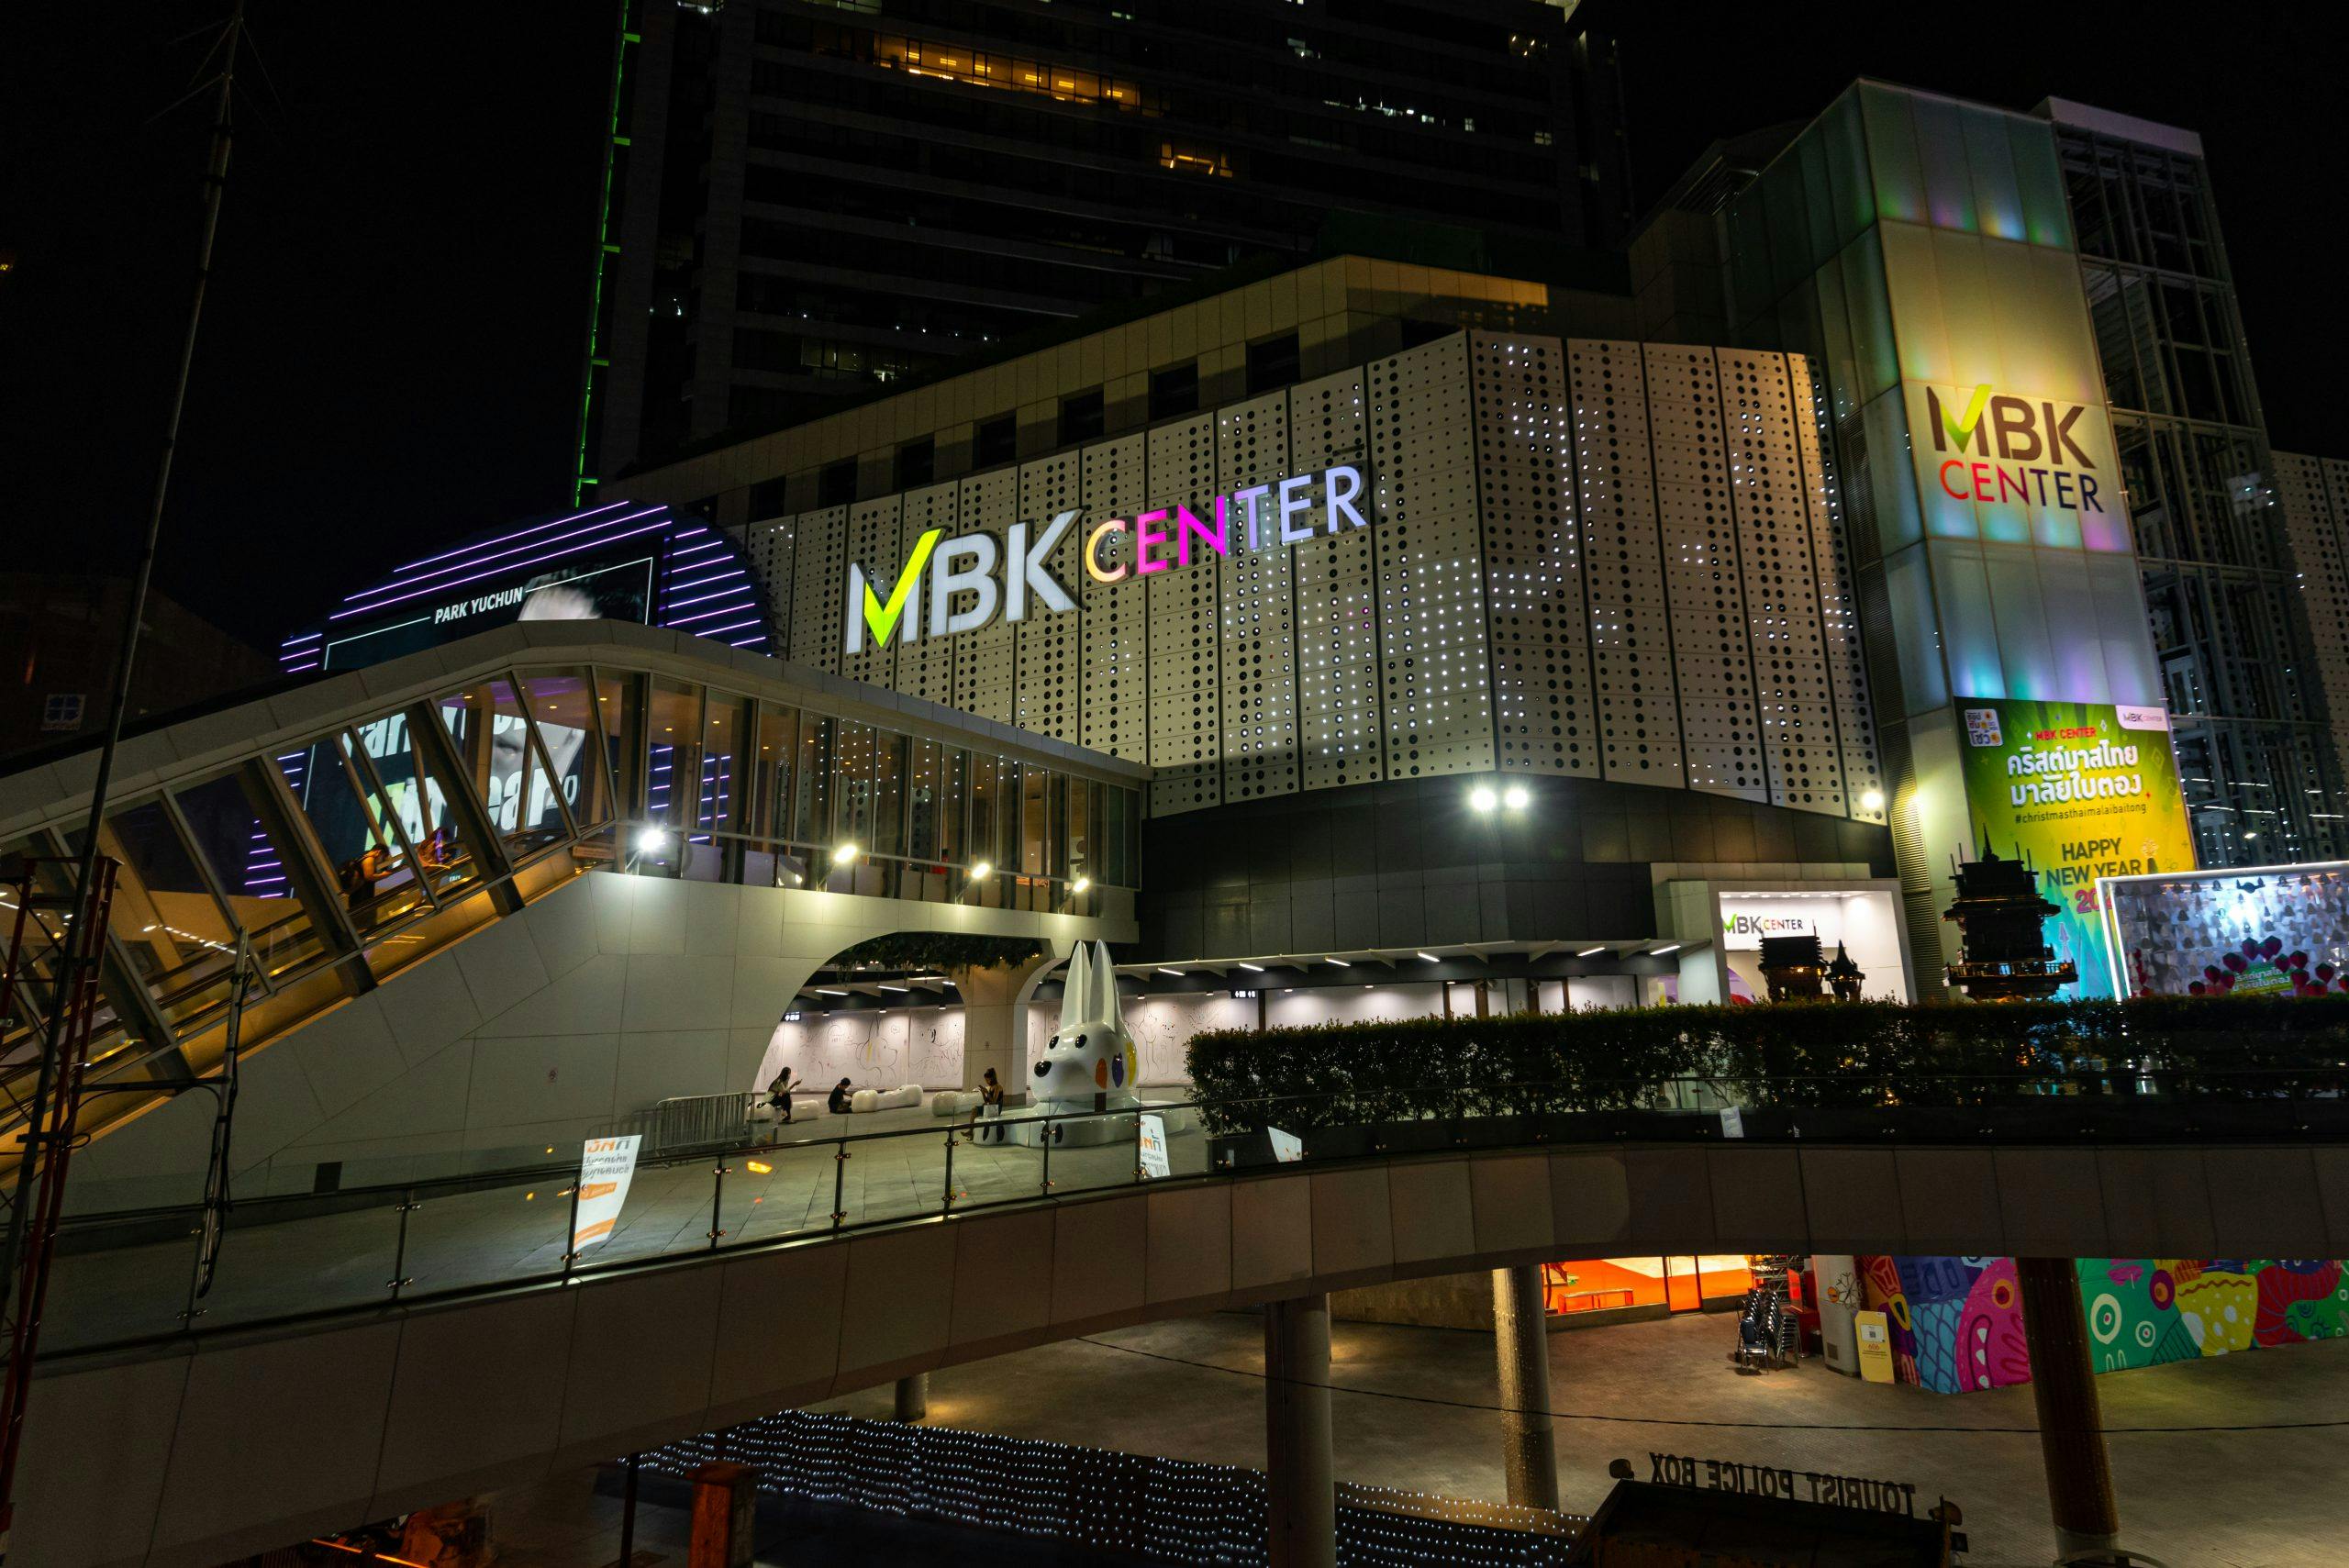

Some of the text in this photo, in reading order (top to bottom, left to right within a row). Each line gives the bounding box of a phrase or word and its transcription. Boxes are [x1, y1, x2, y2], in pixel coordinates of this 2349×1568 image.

[1927, 384, 2097, 469] MBK
[1939, 460, 2104, 513] CENTER
[846, 466, 1366, 654] MBK CENTER
[435, 587, 523, 624] PARK YUCHUN
[2035, 727, 2096, 740] MBK CENTER
[2007, 739, 2138, 776] คริสต์มาสไทย
[2010, 770, 2143, 806] มาลัยใบตอง
[2015, 803, 2147, 823] #christmasthaimalaibaitong
[2062, 838, 2121, 862] HAPPY
[2046, 859, 2142, 887] NEW YEAR
[1764, 919, 1803, 930] CENTER
